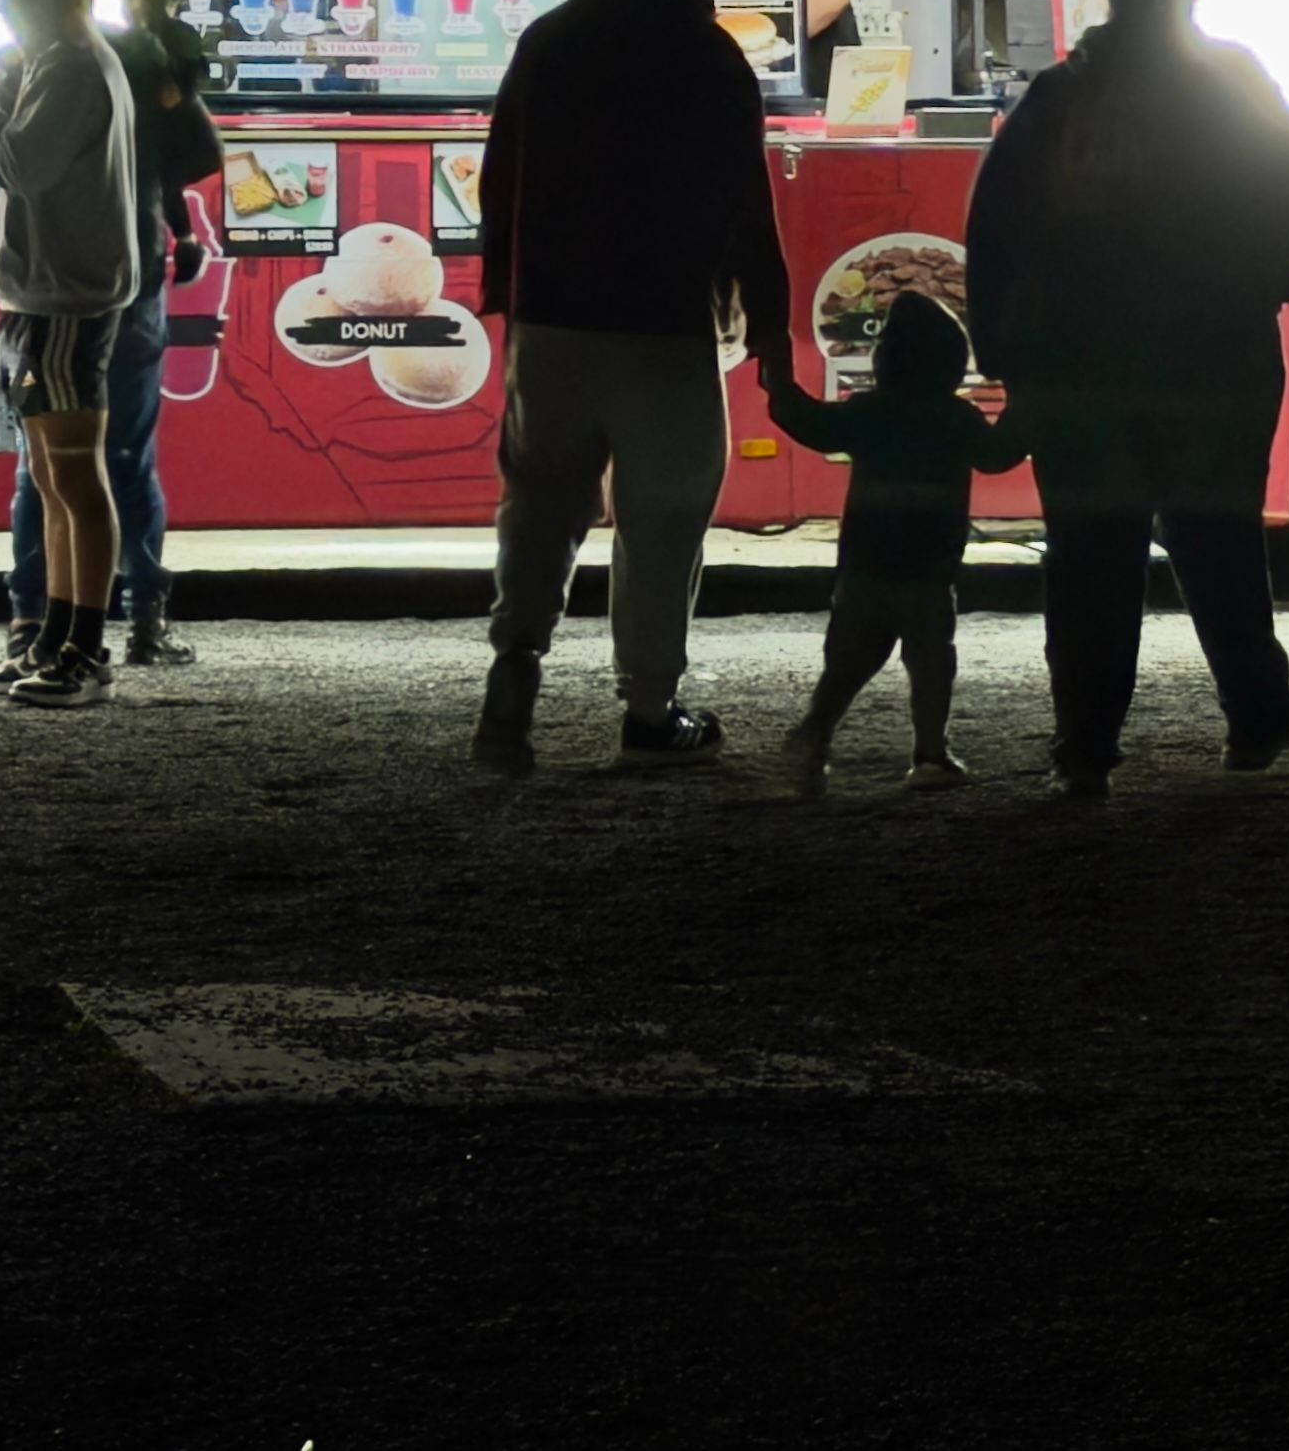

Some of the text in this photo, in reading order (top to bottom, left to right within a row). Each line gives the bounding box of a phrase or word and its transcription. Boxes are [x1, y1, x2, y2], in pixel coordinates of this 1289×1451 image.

[318, 43, 418, 56] STRAWBERRY
[346, 65, 438, 79] RASPBERRY
[341, 322, 408, 341] DONUT
